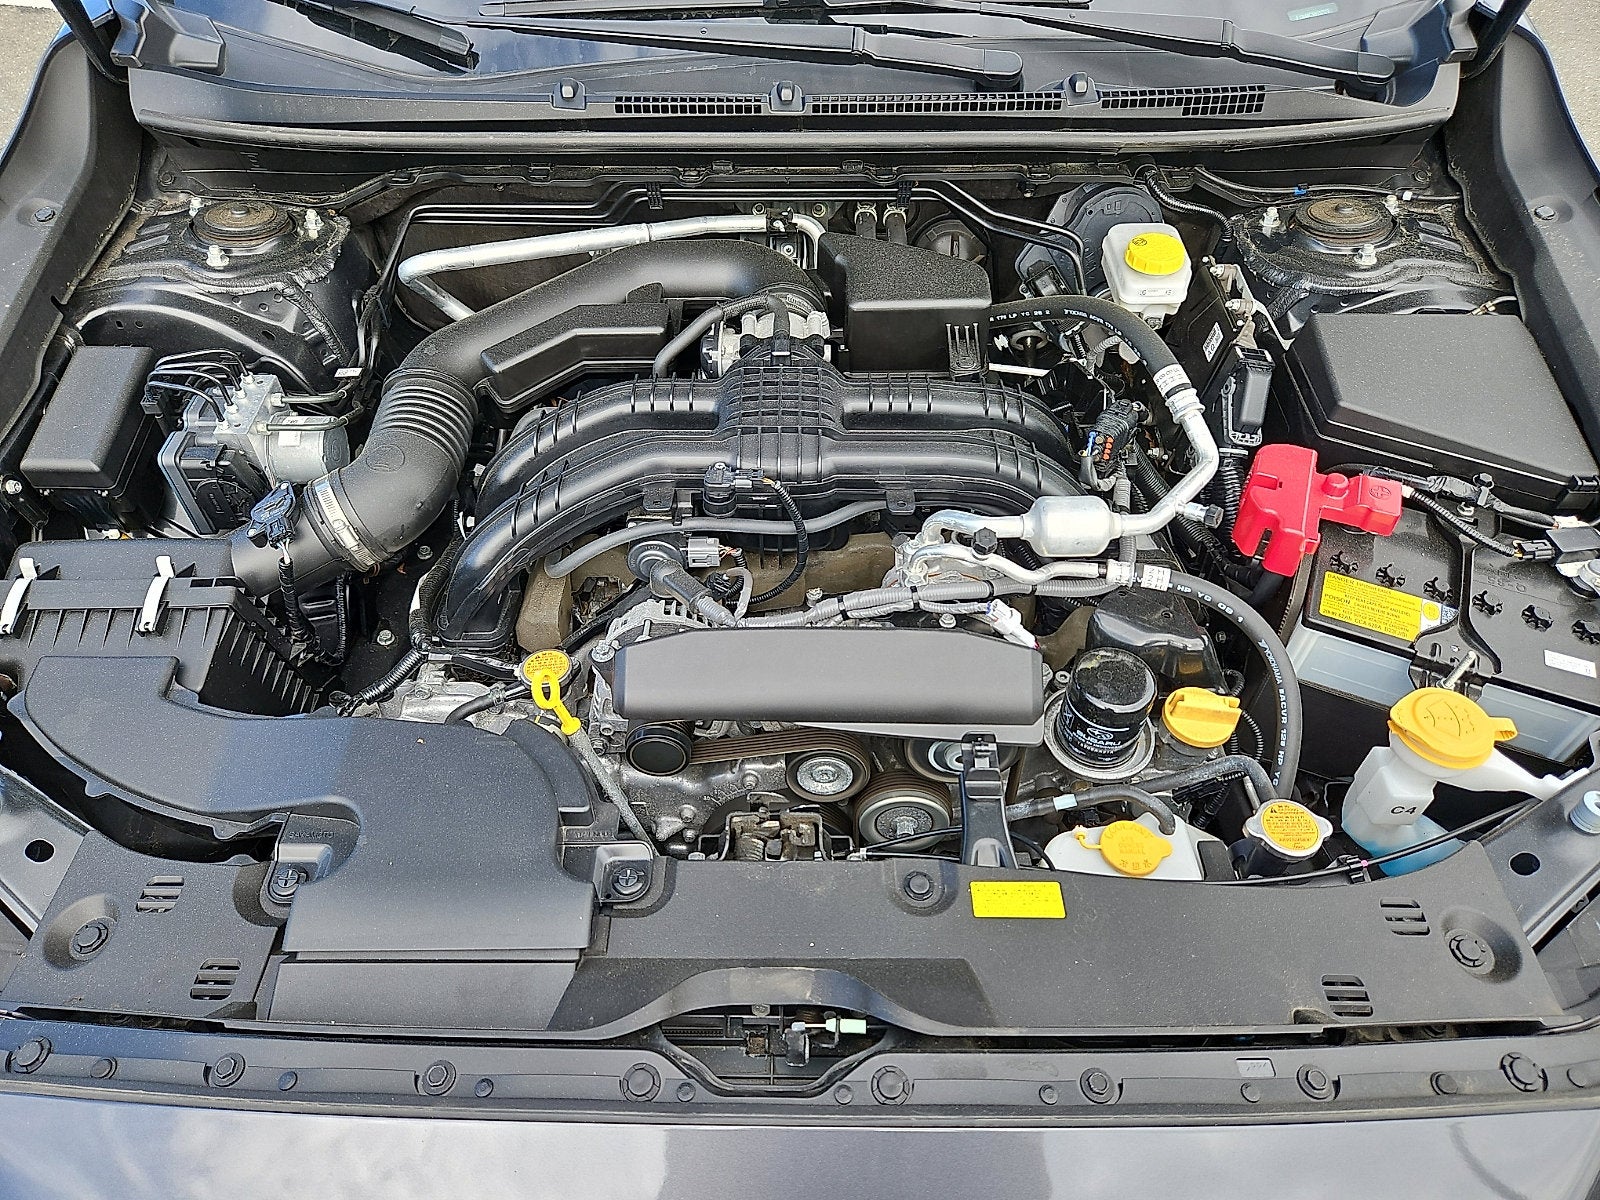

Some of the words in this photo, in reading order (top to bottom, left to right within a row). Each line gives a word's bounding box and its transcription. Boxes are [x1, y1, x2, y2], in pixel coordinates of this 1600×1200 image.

[1327, 574, 1355, 585] DANGER
[1176, 585, 1192, 594] HP
[1324, 594, 1351, 605] POISON
[1262, 645, 1283, 685] YOKOHAMA
[1276, 750, 1285, 766] HP
[1076, 729, 1122, 746] SUBARU
[1390, 805, 1417, 815] C4
